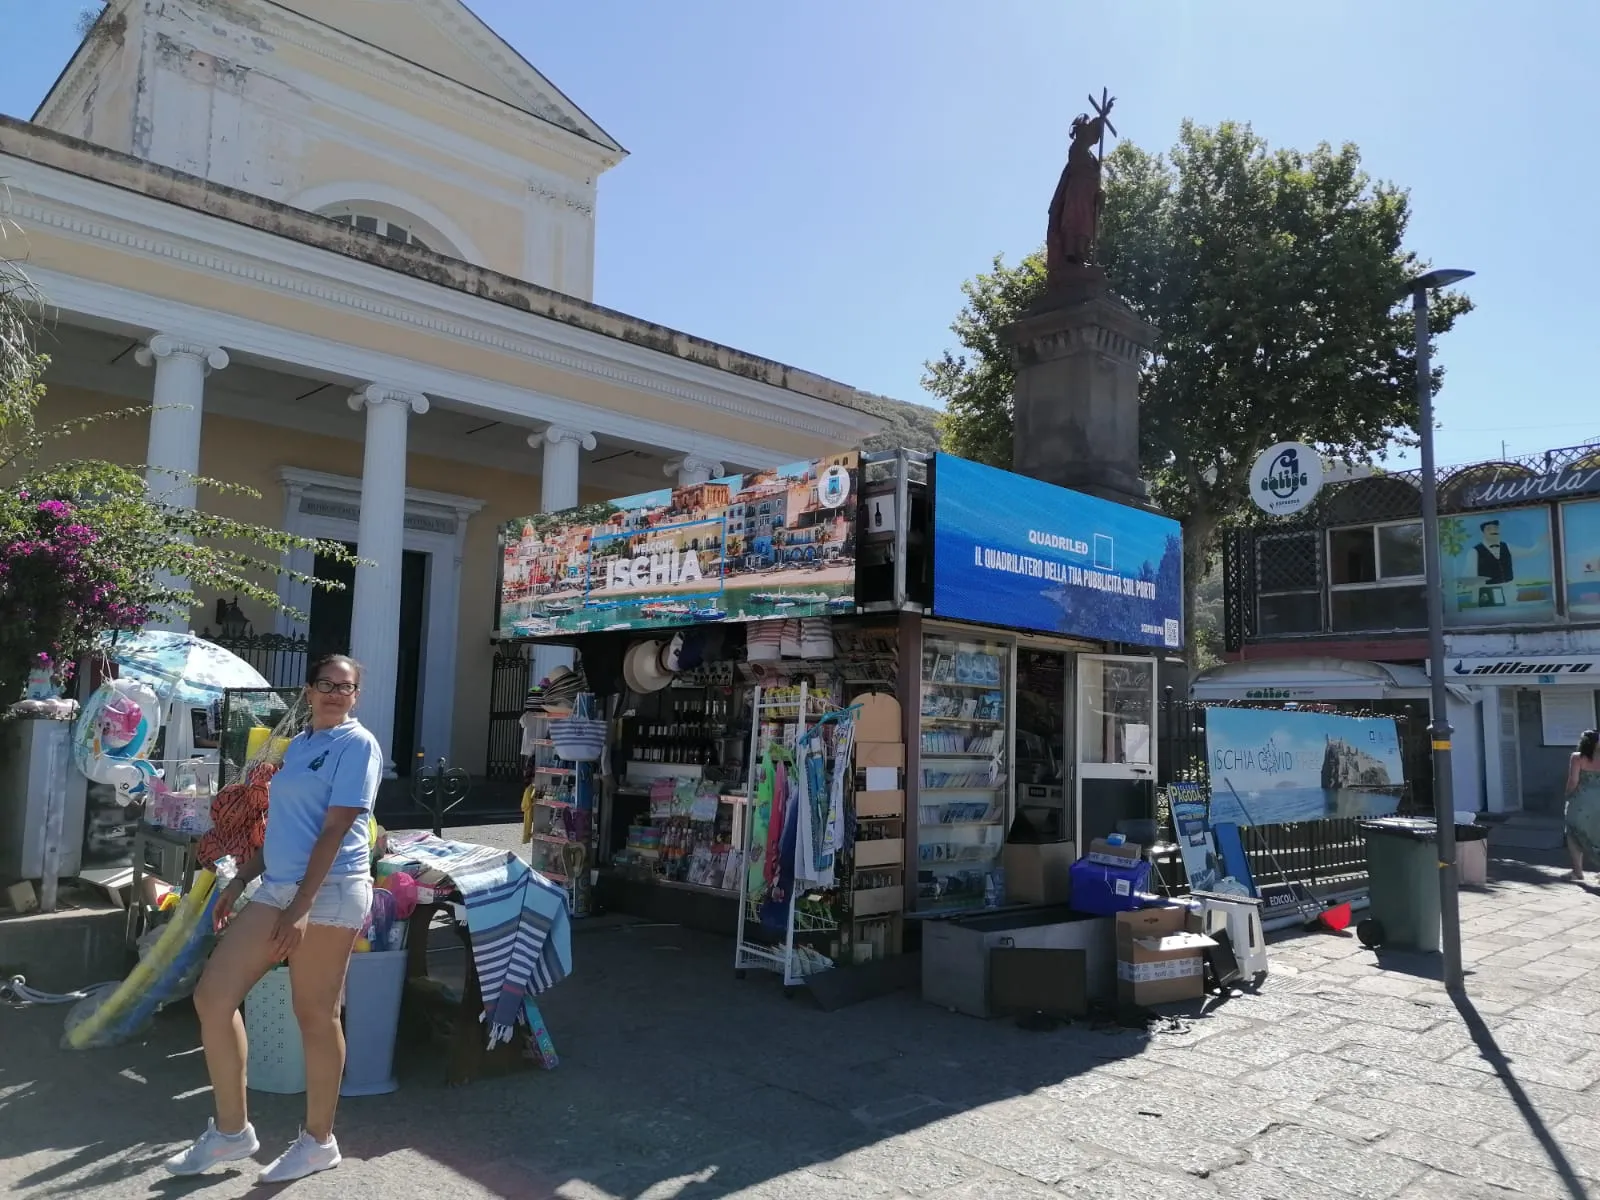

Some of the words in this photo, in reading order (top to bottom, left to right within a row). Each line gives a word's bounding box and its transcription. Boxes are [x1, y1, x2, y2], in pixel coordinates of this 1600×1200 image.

[1028, 529, 1089, 555] QUADRILED
[606, 549, 703, 590] ISCHIA
[975, 545, 983, 567] IL
[984, 548, 1043, 578] QUADRILATERO
[1044, 560, 1067, 584] DELLA
[1067, 565, 1083, 587] TUA
[1122, 577, 1136, 596] SUL
[1136, 580, 1156, 600] PORTO
[1213, 748, 1255, 771] ISCHIA
